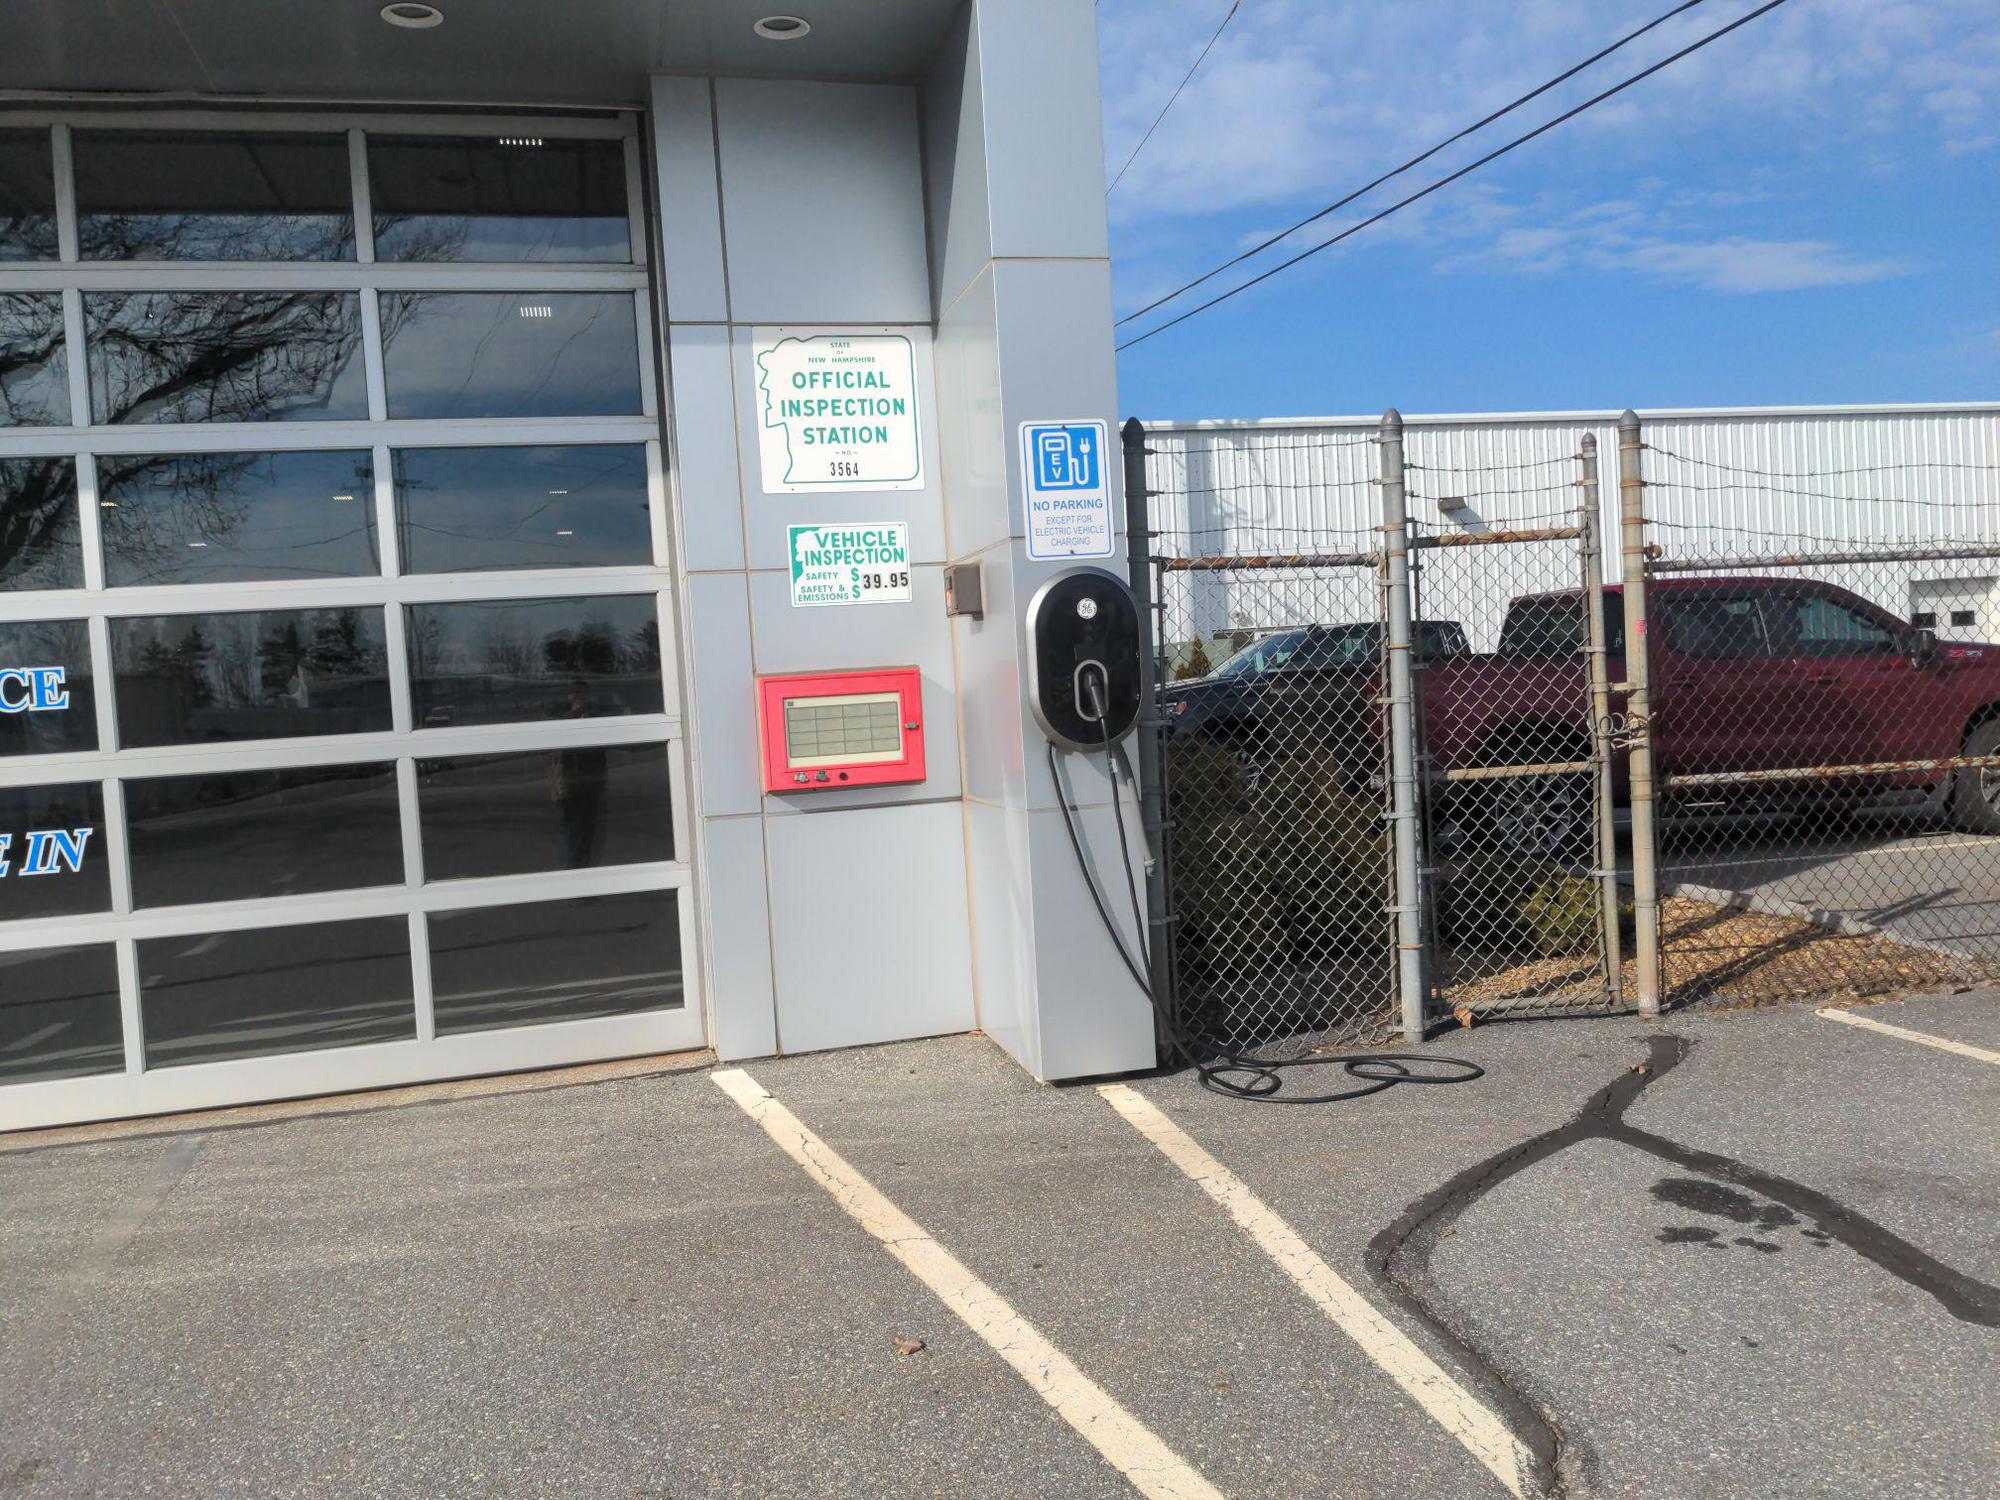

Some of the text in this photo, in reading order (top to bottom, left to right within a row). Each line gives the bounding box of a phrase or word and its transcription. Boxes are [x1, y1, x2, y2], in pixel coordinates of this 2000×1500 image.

[792, 371, 891, 389] OFFICIAL
[781, 398, 905, 417] INSPECTION
[803, 426, 888, 445] STATION
[830, 461, 859, 477] 3564
[1033, 498, 1103, 511] NO PARKING
[1046, 514, 1093, 525] EXCEPT FOR
[814, 530, 897, 549] VEHICLE
[1035, 525, 1105, 537] ELECTRIC VEHICLE
[1050, 536, 1091, 546] CHARGING
[804, 547, 905, 566] INSPECTION
[800, 584, 834, 594] SAFETY
[838, 584, 845, 592] &
[805, 572, 839, 581] SAFETY
[863, 572, 909, 589] 39.95
[798, 592, 849, 602] EMISSIONS
[0, 666, 70, 714] CE
[19, 827, 93, 876] IN
